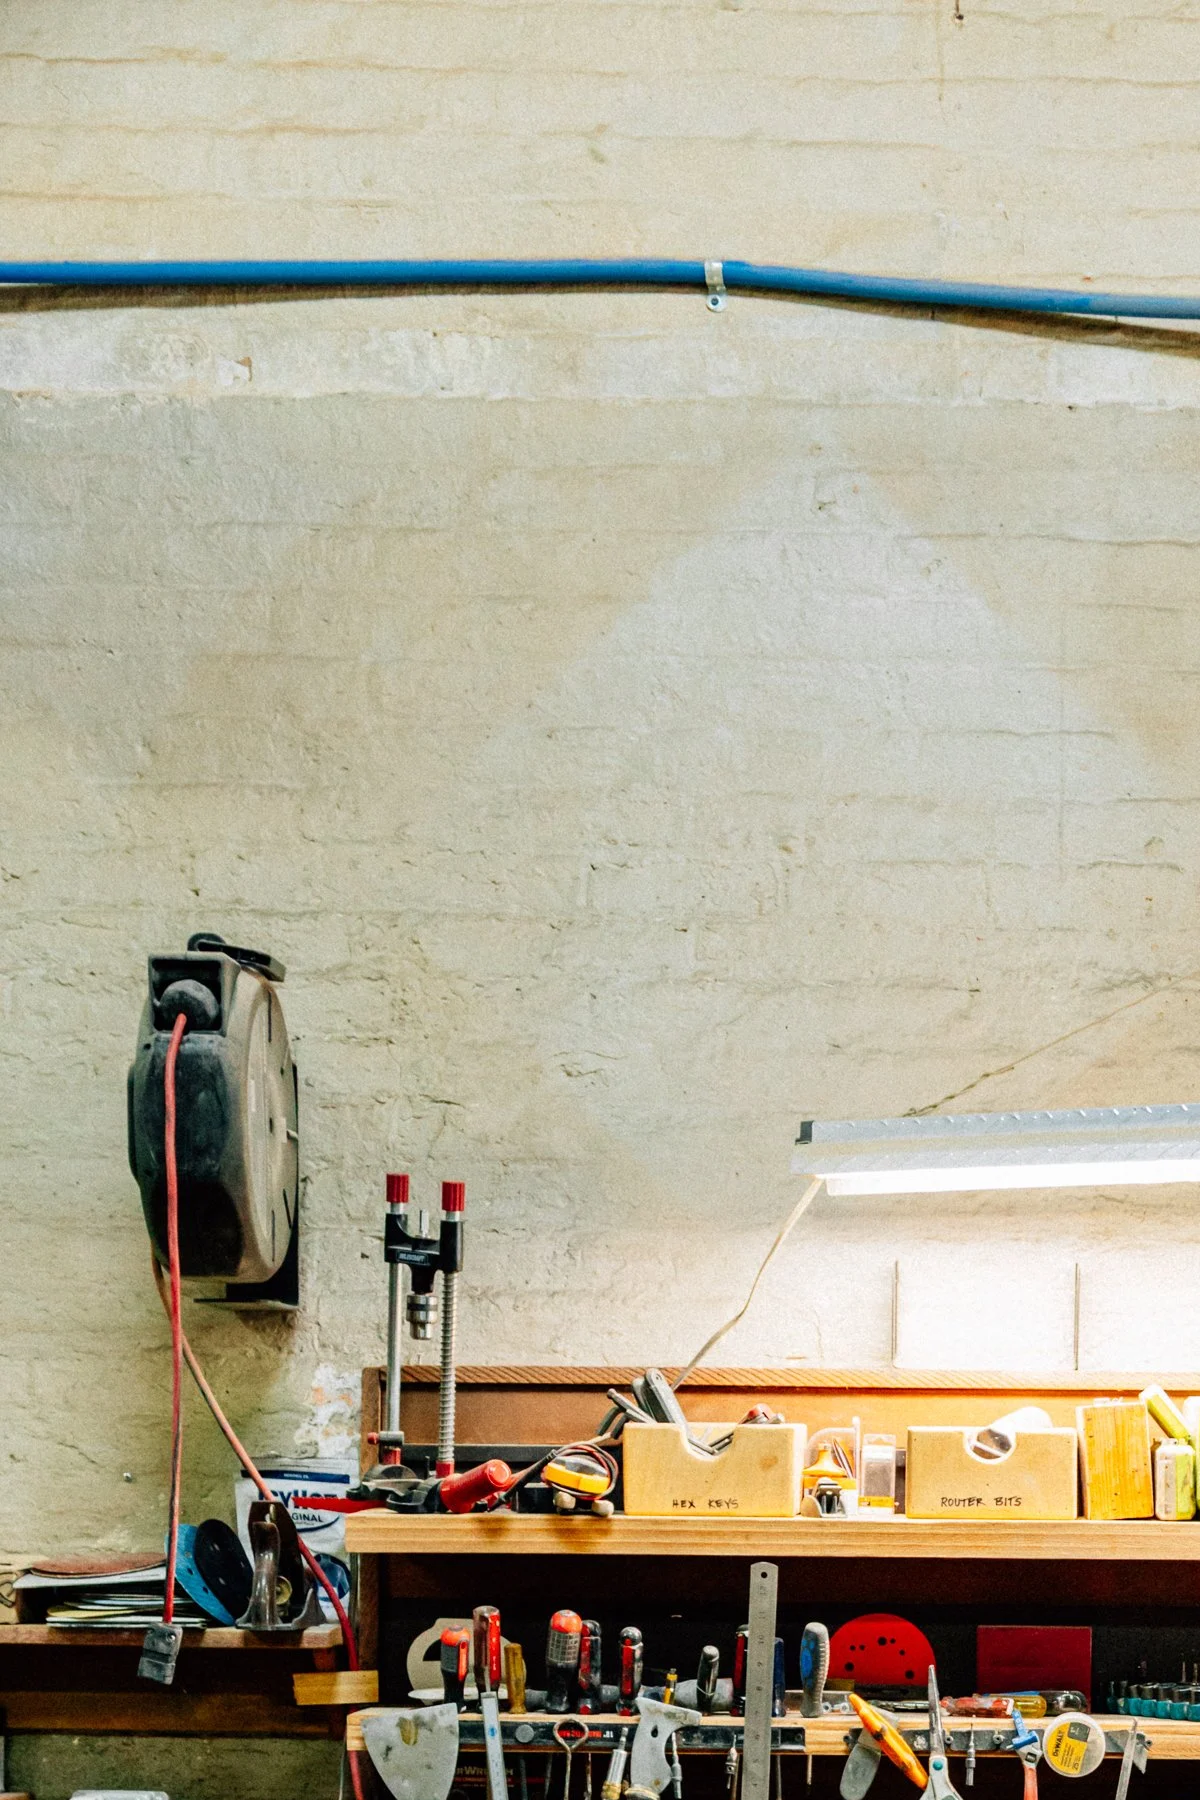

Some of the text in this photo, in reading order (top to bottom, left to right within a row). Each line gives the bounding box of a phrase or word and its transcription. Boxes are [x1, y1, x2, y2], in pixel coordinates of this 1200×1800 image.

[672, 1498, 739, 1509] HEX KEYS
[940, 1496, 1022, 1507] ROUTER BITS
[291, 1512, 324, 1522] GINAL
